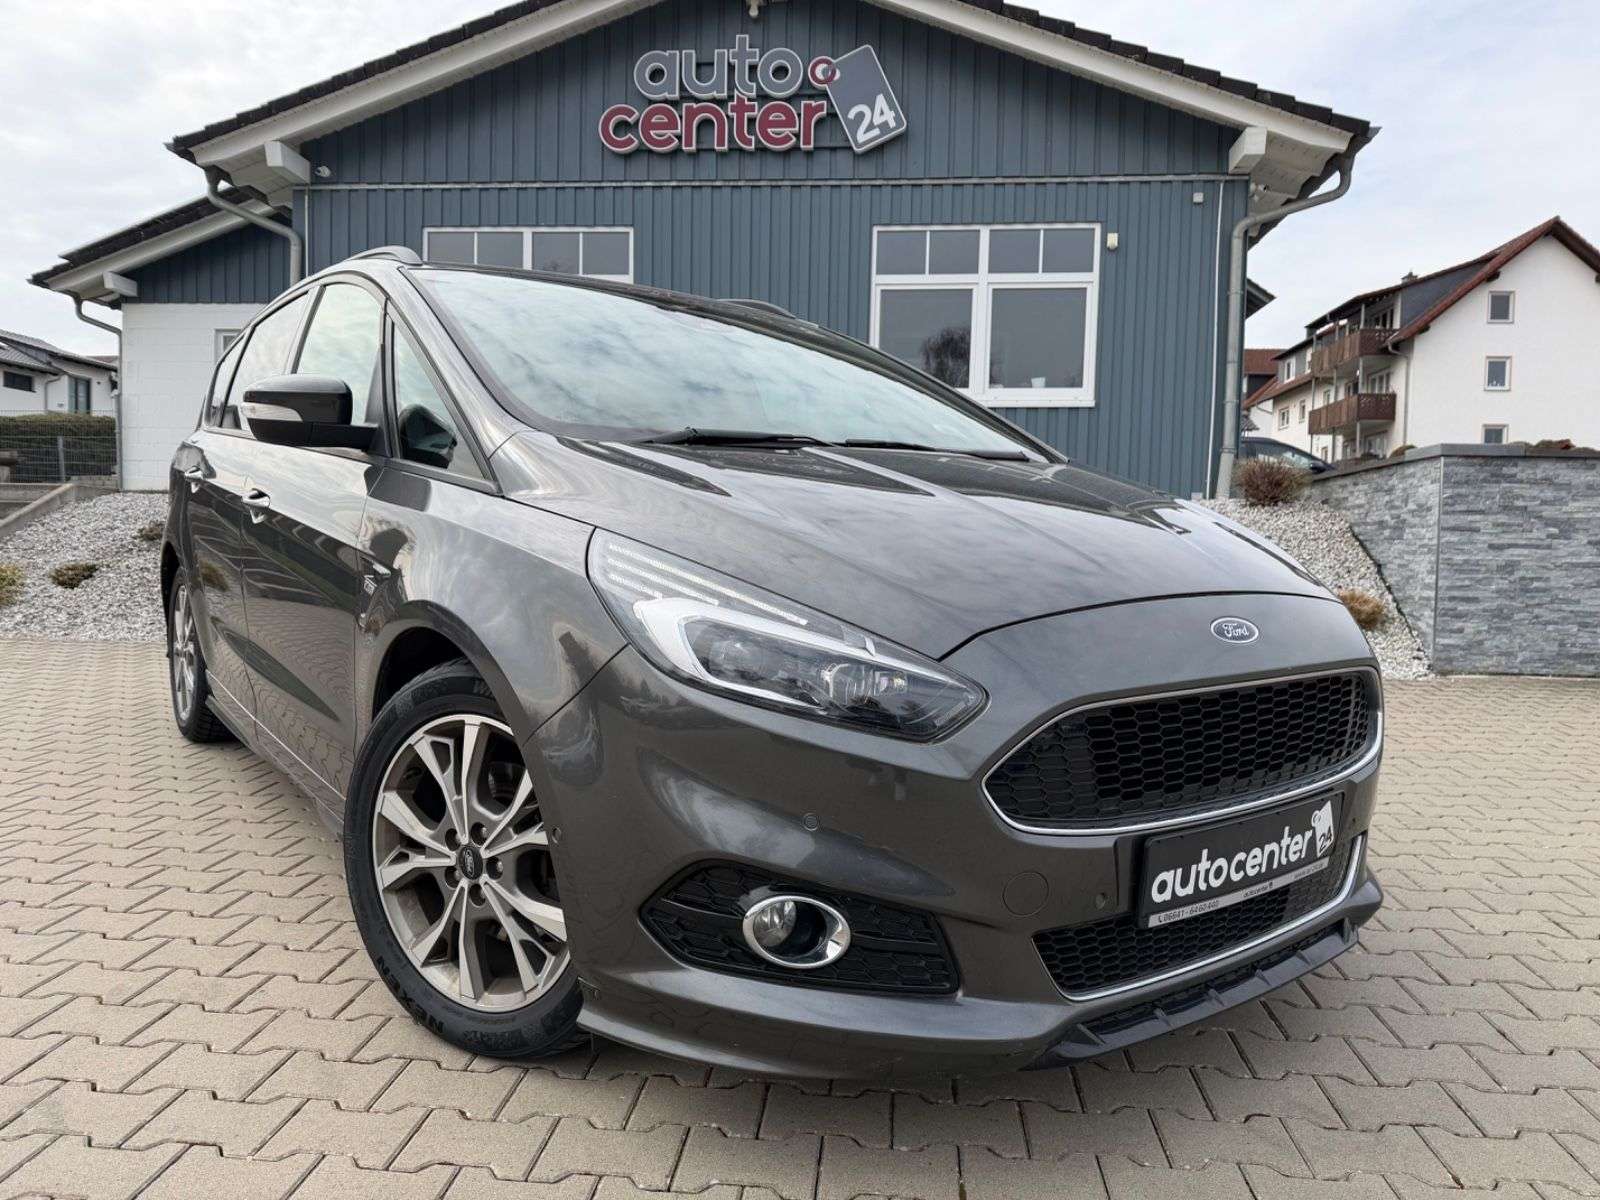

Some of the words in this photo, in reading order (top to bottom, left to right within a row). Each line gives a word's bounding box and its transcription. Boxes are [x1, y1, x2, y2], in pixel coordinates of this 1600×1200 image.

[633, 34, 804, 99] auto
[599, 91, 828, 153] center
[847, 93, 897, 144] 24
[1151, 826, 1313, 904] autocenter
[1318, 827, 1333, 851] 24
